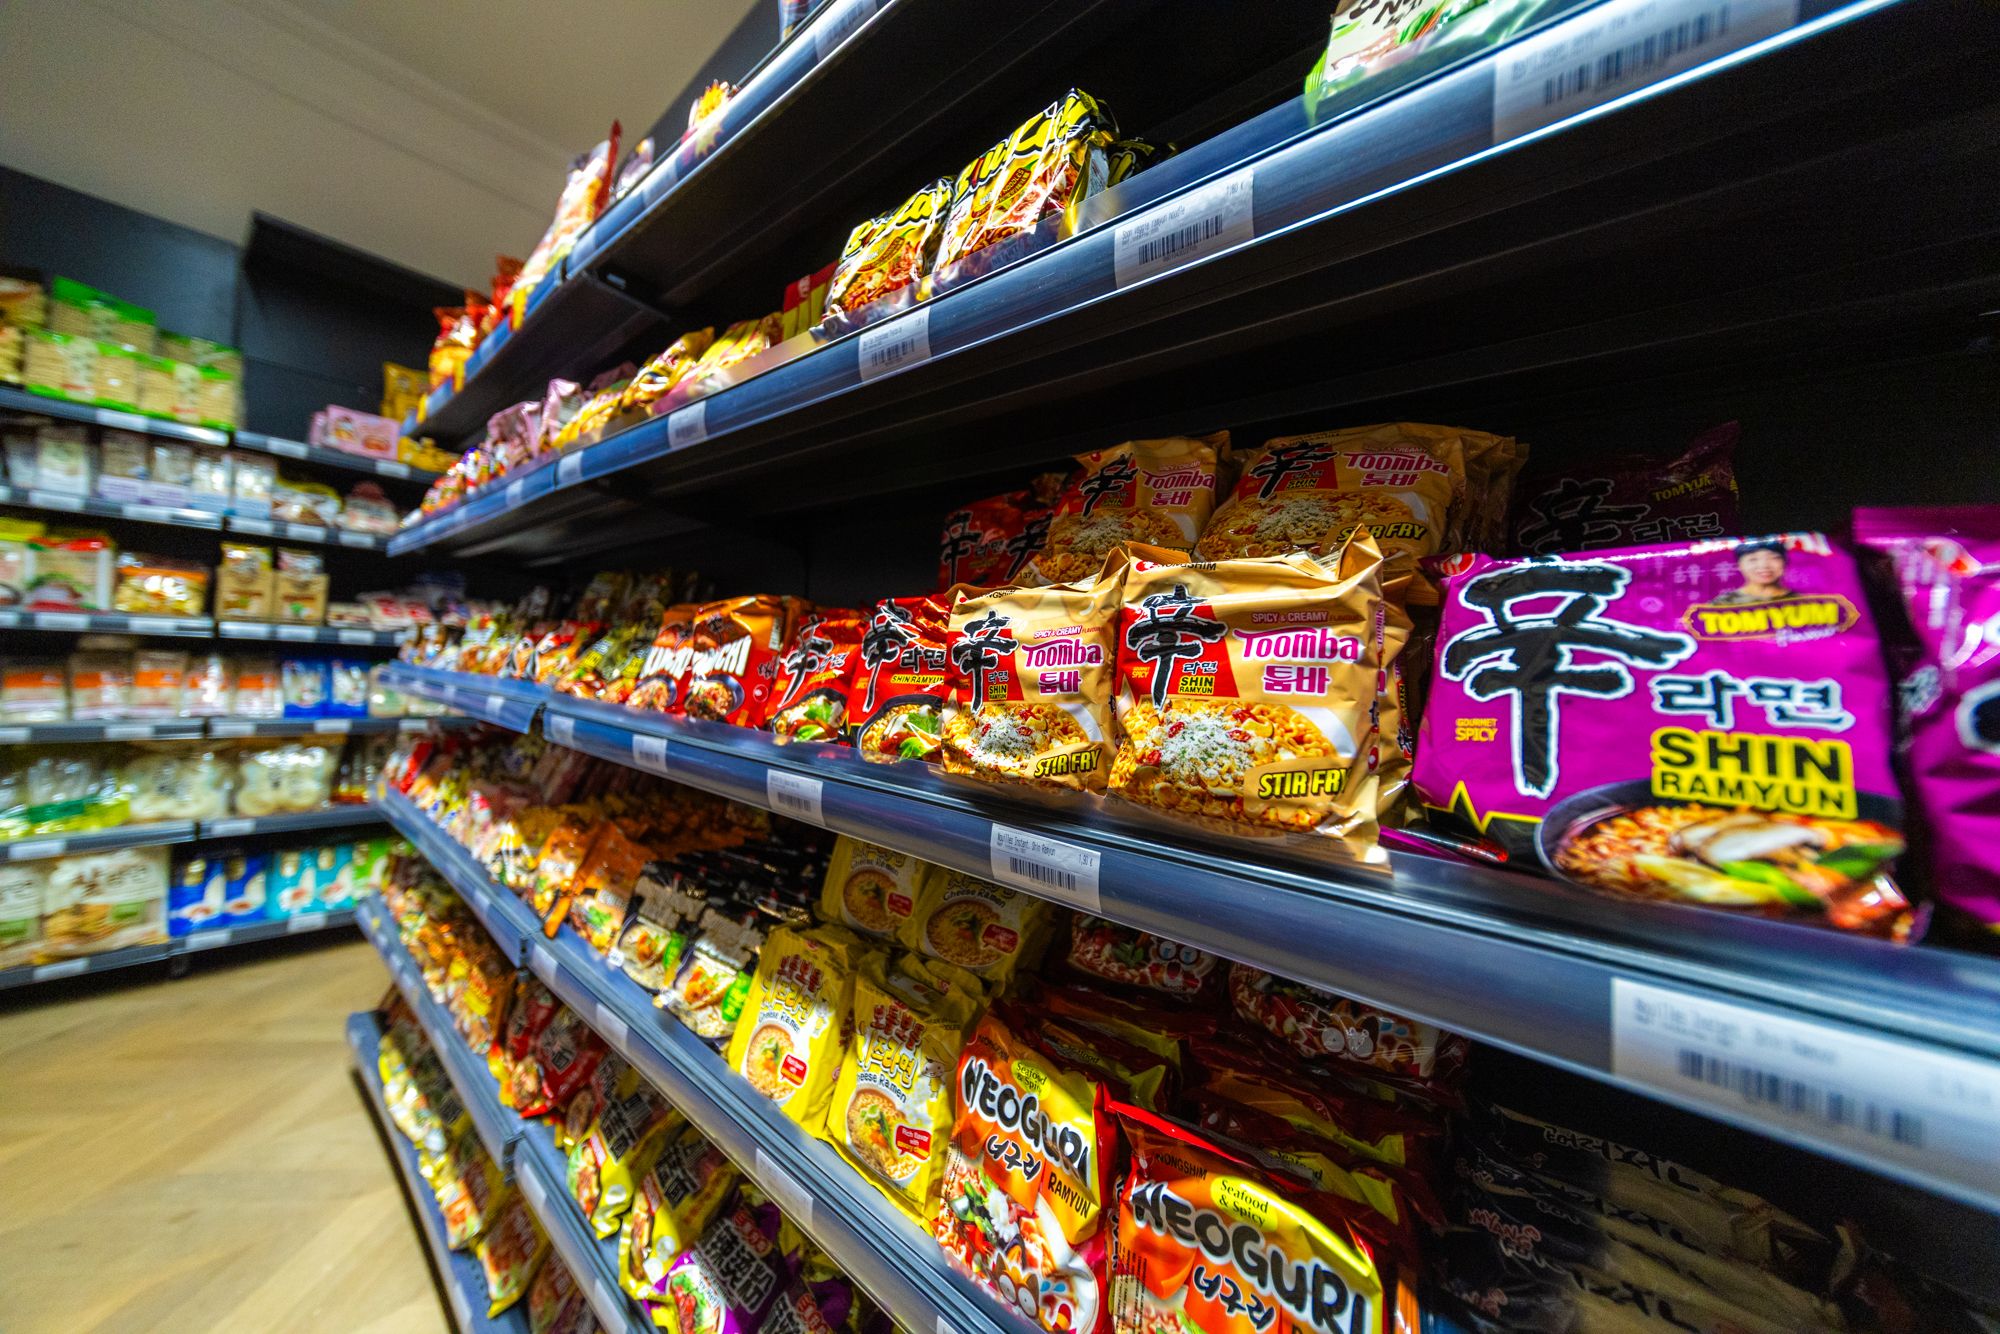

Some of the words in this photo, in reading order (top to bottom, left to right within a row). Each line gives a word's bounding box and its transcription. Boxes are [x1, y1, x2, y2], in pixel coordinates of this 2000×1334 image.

[1342, 451, 1450, 475] Toomba
[1140, 469, 1217, 490] Toomba
[1385, 523, 1428, 541] FRY
[1252, 613, 1278, 623] SPICY
[1287, 611, 1328, 622] CREAMY
[1021, 638, 1102, 668] Toomba
[1126, 584, 1228, 713] 辛
[1232, 625, 1362, 662] Toomba
[951, 609, 1020, 715] 辛
[1439, 557, 1698, 799] 辛
[892, 676, 915, 684] SHIN
[988, 684, 1007, 694] SHIN
[1179, 686, 1213, 694] RAMYUN
[1180, 676, 1214, 687] SHIN
[1650, 670, 1857, 733] 라면
[1454, 725, 1498, 743] SPICY
[1033, 754, 1069, 778] STIR
[1070, 749, 1101, 773] FRY
[1657, 731, 1846, 783] SHIN
[1258, 773, 1308, 799] STIR
[1658, 770, 1849, 816] RAMYUN
[879, 1073, 907, 1104] Ramen
[986, 1135, 1041, 1181] 너구리
[1047, 1171, 1091, 1220] RAMYUN
[1219, 1194, 1229, 1207] &
[1232, 1203, 1267, 1228] Spicy
[1220, 1179, 1270, 1215] Seafood
[1129, 1181, 1366, 1334] NEOGURI
[1192, 1266, 1276, 1331] 너구리
